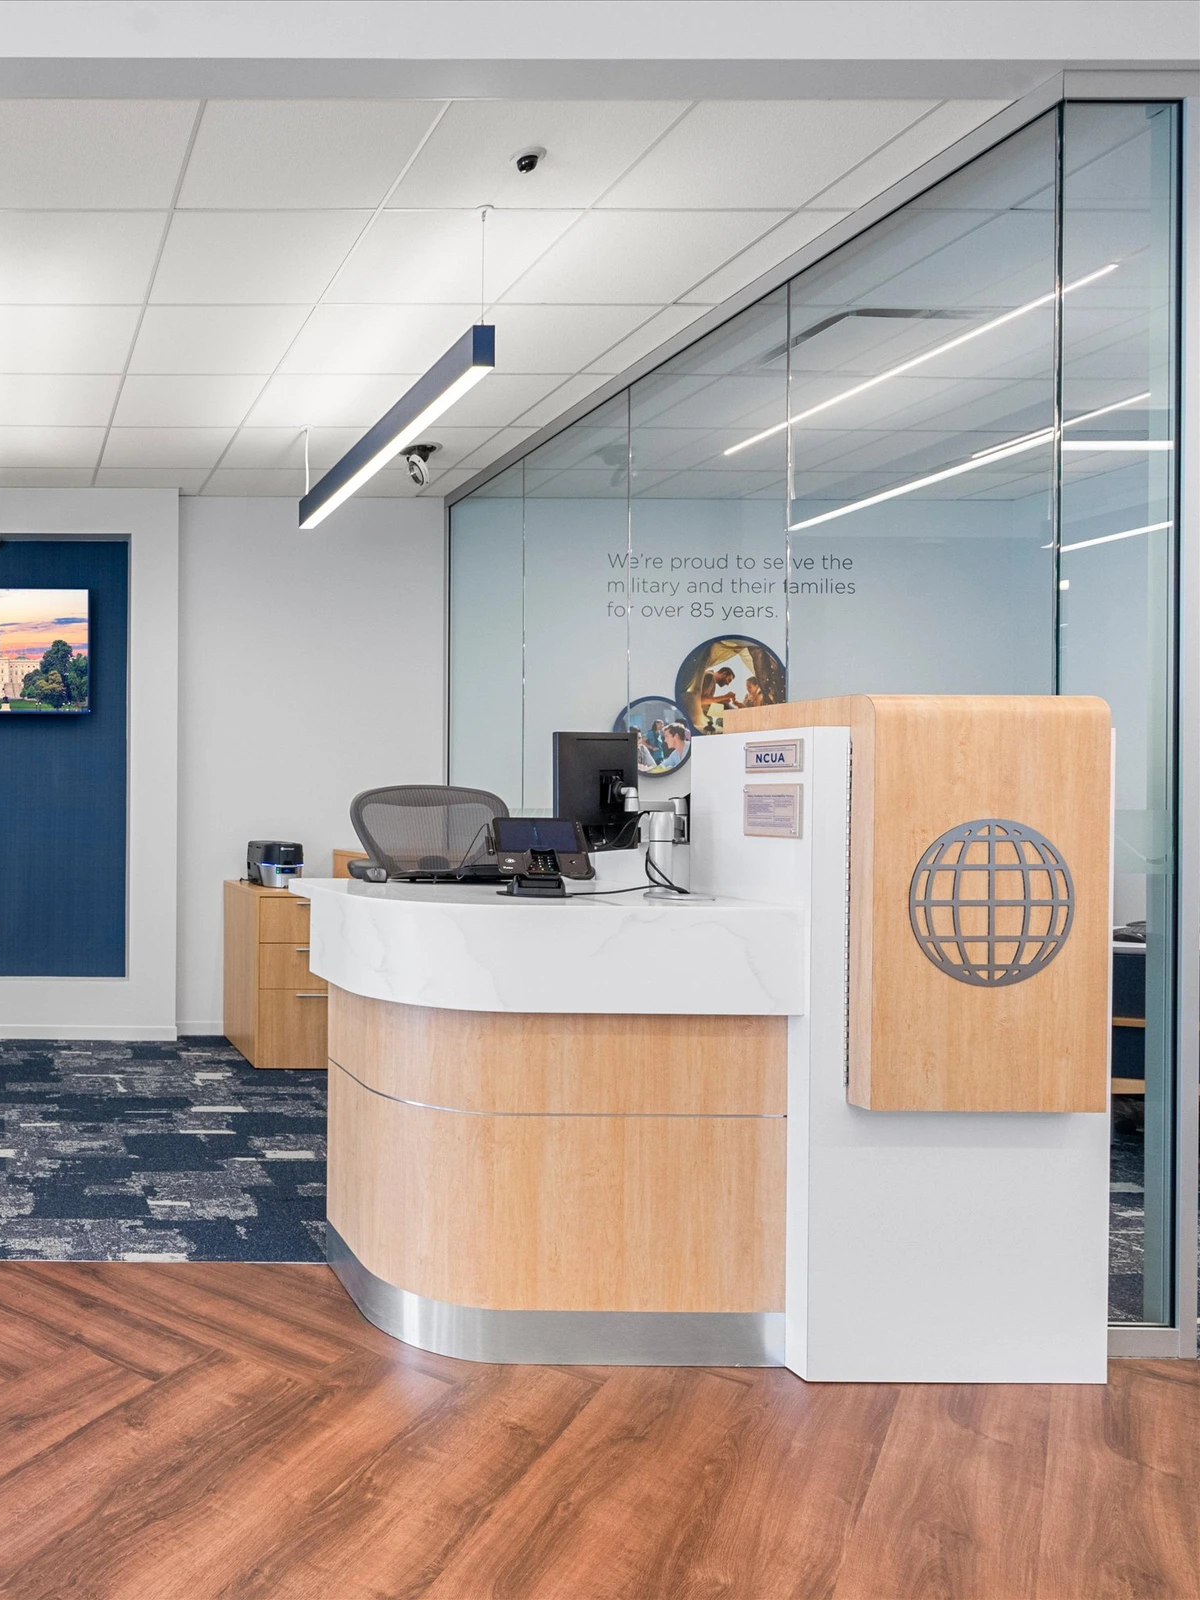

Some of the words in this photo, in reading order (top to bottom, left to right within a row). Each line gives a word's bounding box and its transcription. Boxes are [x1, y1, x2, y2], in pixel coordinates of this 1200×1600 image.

[670, 553, 729, 572] proud
[736, 554, 756, 570] to
[763, 556, 815, 570] seve
[821, 554, 853, 571] the
[607, 577, 681, 597] mlitary
[686, 577, 724, 594] and
[730, 577, 776, 594] their
[783, 577, 856, 595] families
[641, 604, 684, 618] over
[690, 601, 715, 618] 85
[721, 604, 779, 621] years.
[755, 752, 786, 764] NCUA
